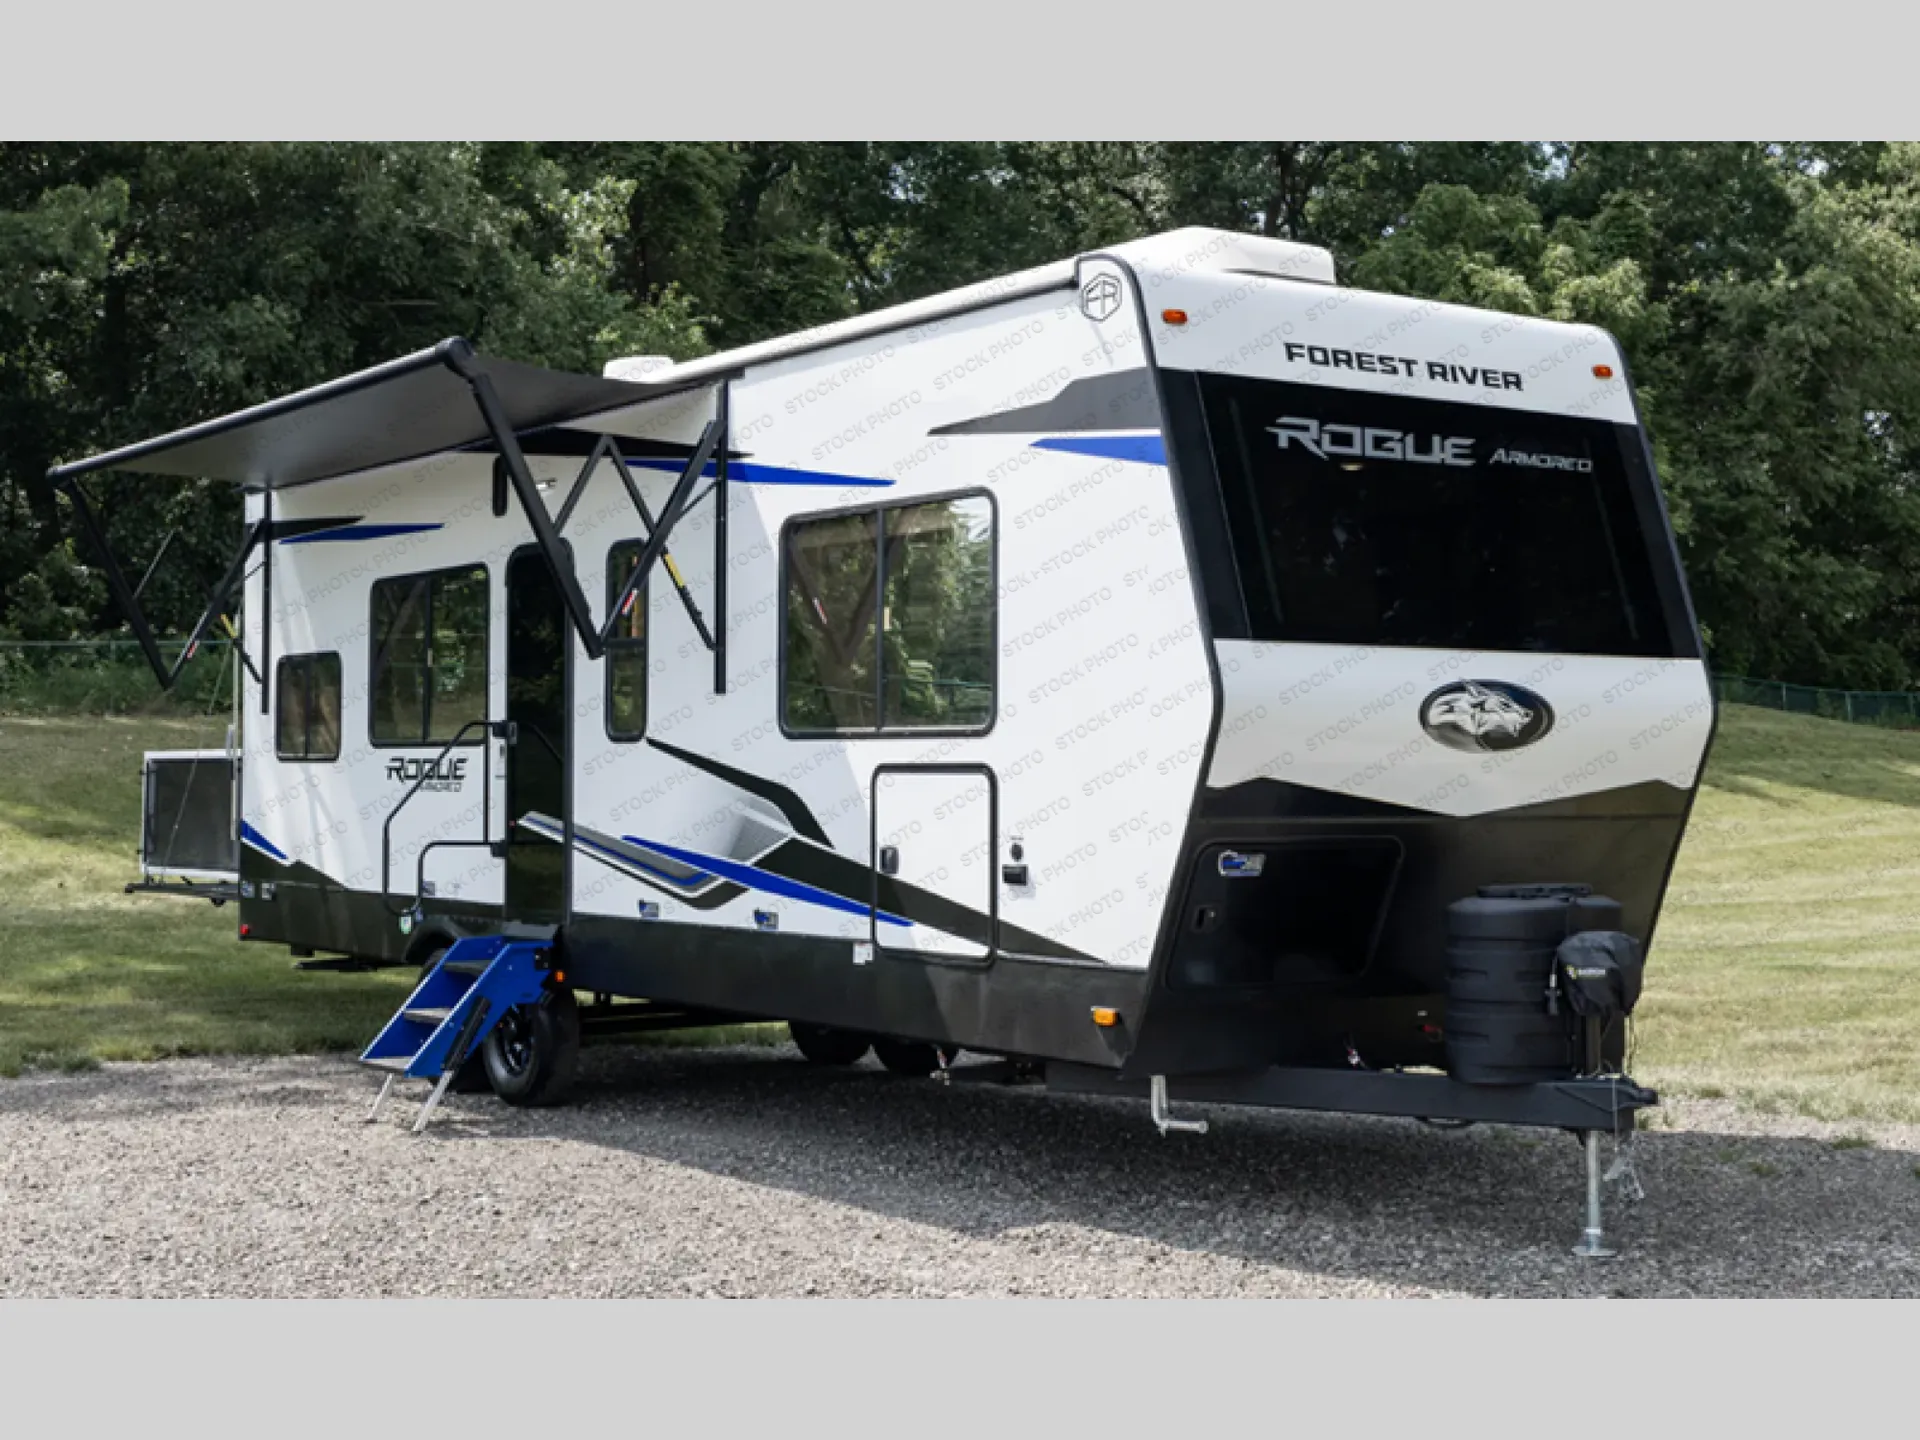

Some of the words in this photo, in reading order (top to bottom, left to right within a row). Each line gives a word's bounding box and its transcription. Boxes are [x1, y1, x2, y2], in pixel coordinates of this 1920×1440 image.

[1284, 342, 1419, 377] FOREST
[1427, 361, 1523, 391] RIVER
[1265, 416, 1477, 466] ROGUE
